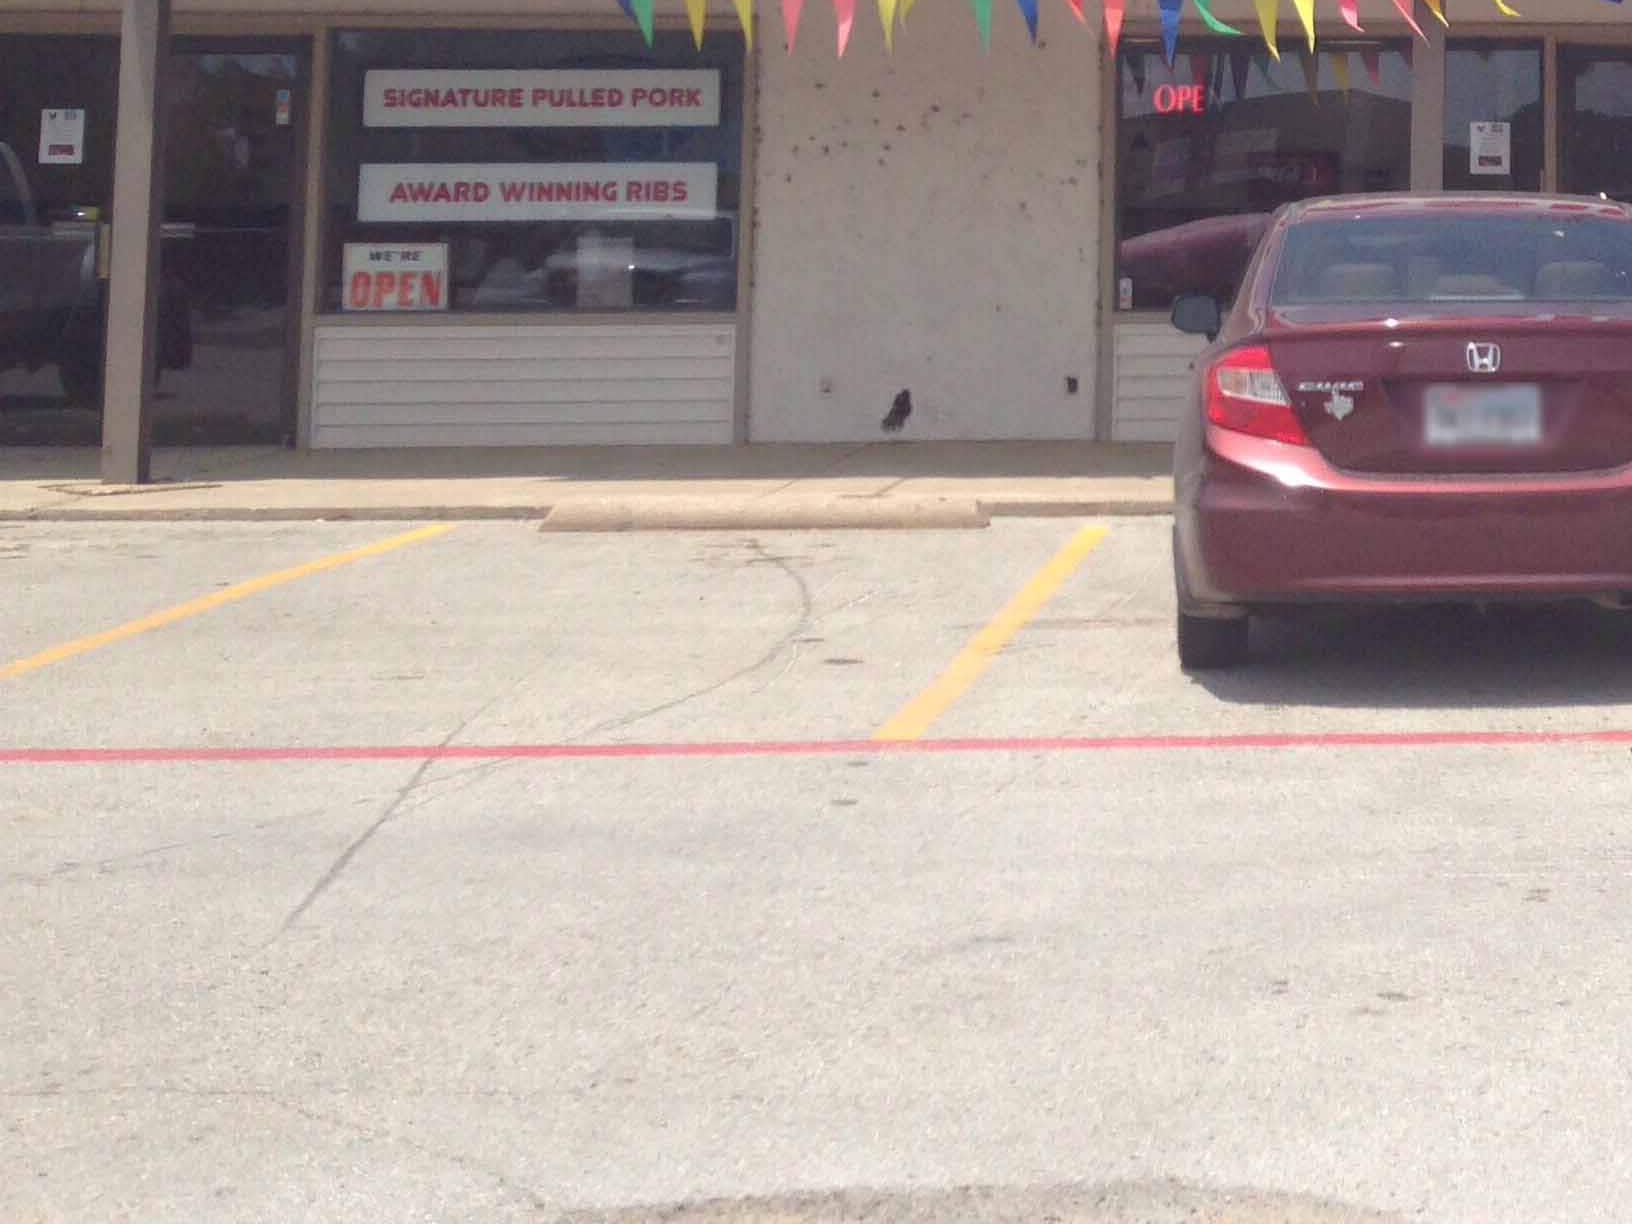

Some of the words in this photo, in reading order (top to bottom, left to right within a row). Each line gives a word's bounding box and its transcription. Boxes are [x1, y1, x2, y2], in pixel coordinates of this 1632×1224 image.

[383, 88, 524, 108] SIGNATURE
[531, 88, 625, 108] PULLED
[631, 88, 702, 108] PORK
[389, 181, 491, 204] AWARD
[499, 181, 618, 203] WINNING
[625, 181, 688, 202] RIBS
[350, 271, 443, 309] OPEN
